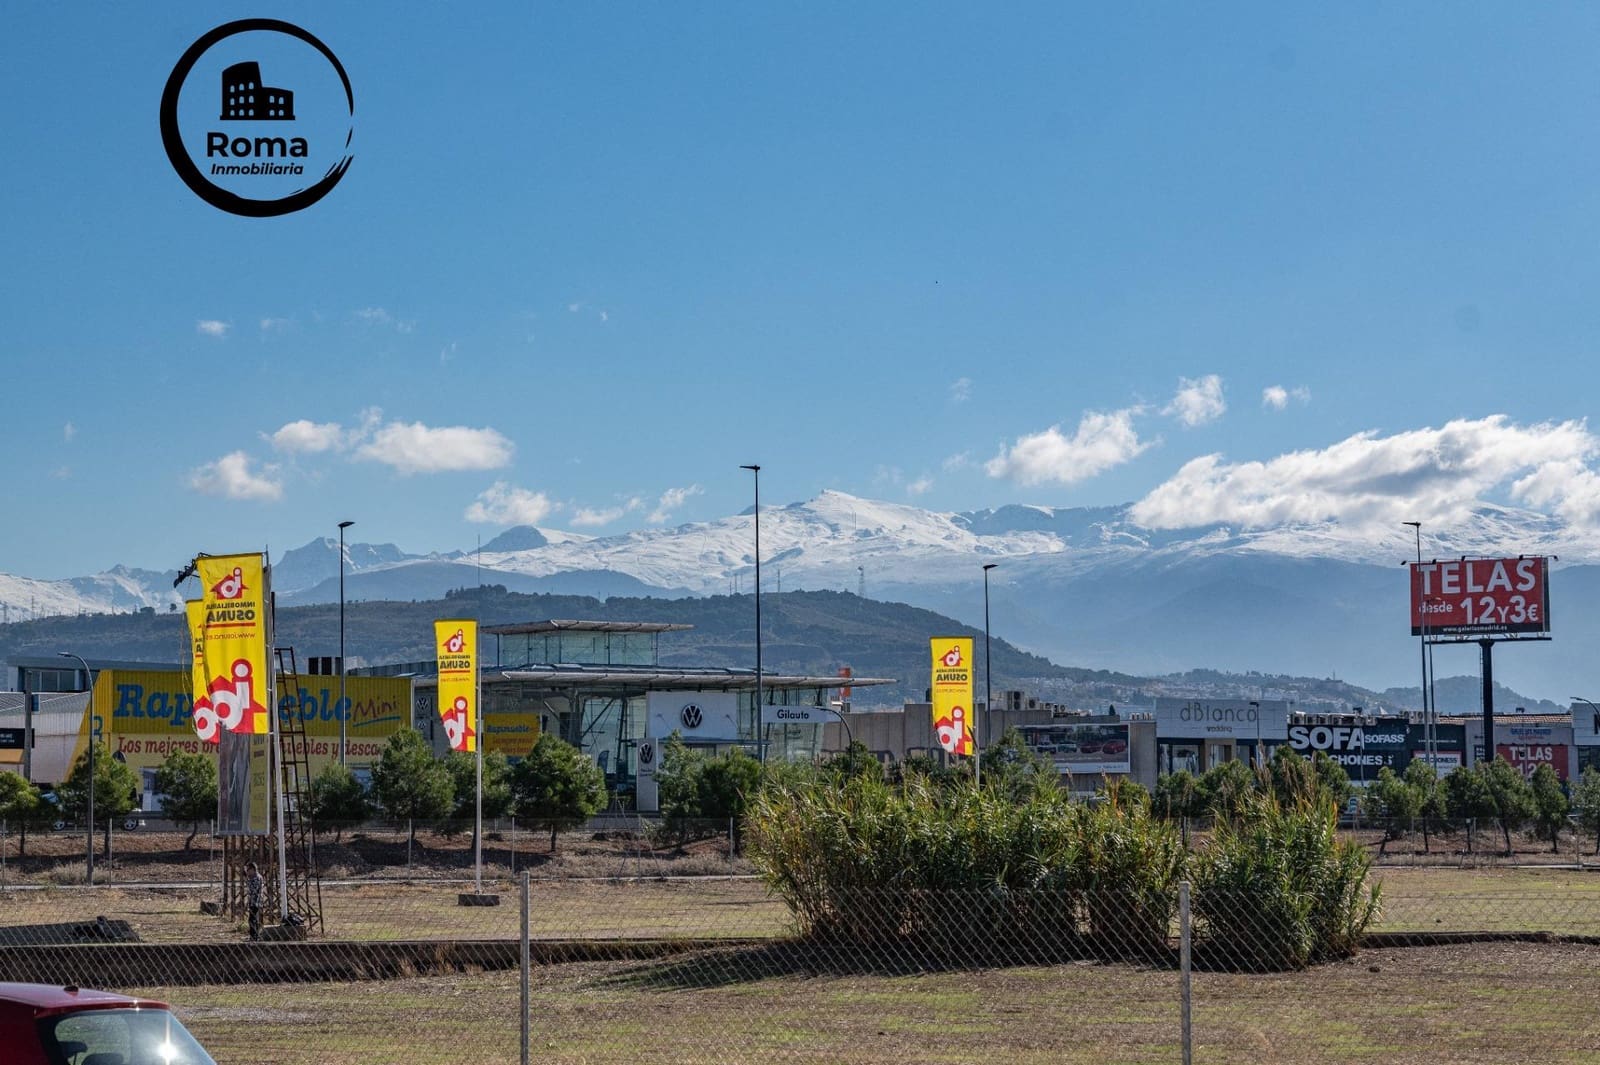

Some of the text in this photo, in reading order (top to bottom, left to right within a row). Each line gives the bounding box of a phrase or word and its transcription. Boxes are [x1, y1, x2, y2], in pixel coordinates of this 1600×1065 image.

[1417, 559, 1536, 595] TELAS
[1419, 601, 1453, 613] desde
[353, 695, 398, 722] Mini
[777, 709, 809, 720] Gilauto
[118, 737, 141, 753] Los
[1289, 726, 1364, 750] SOFA
[1510, 746, 1553, 760] TELAS
